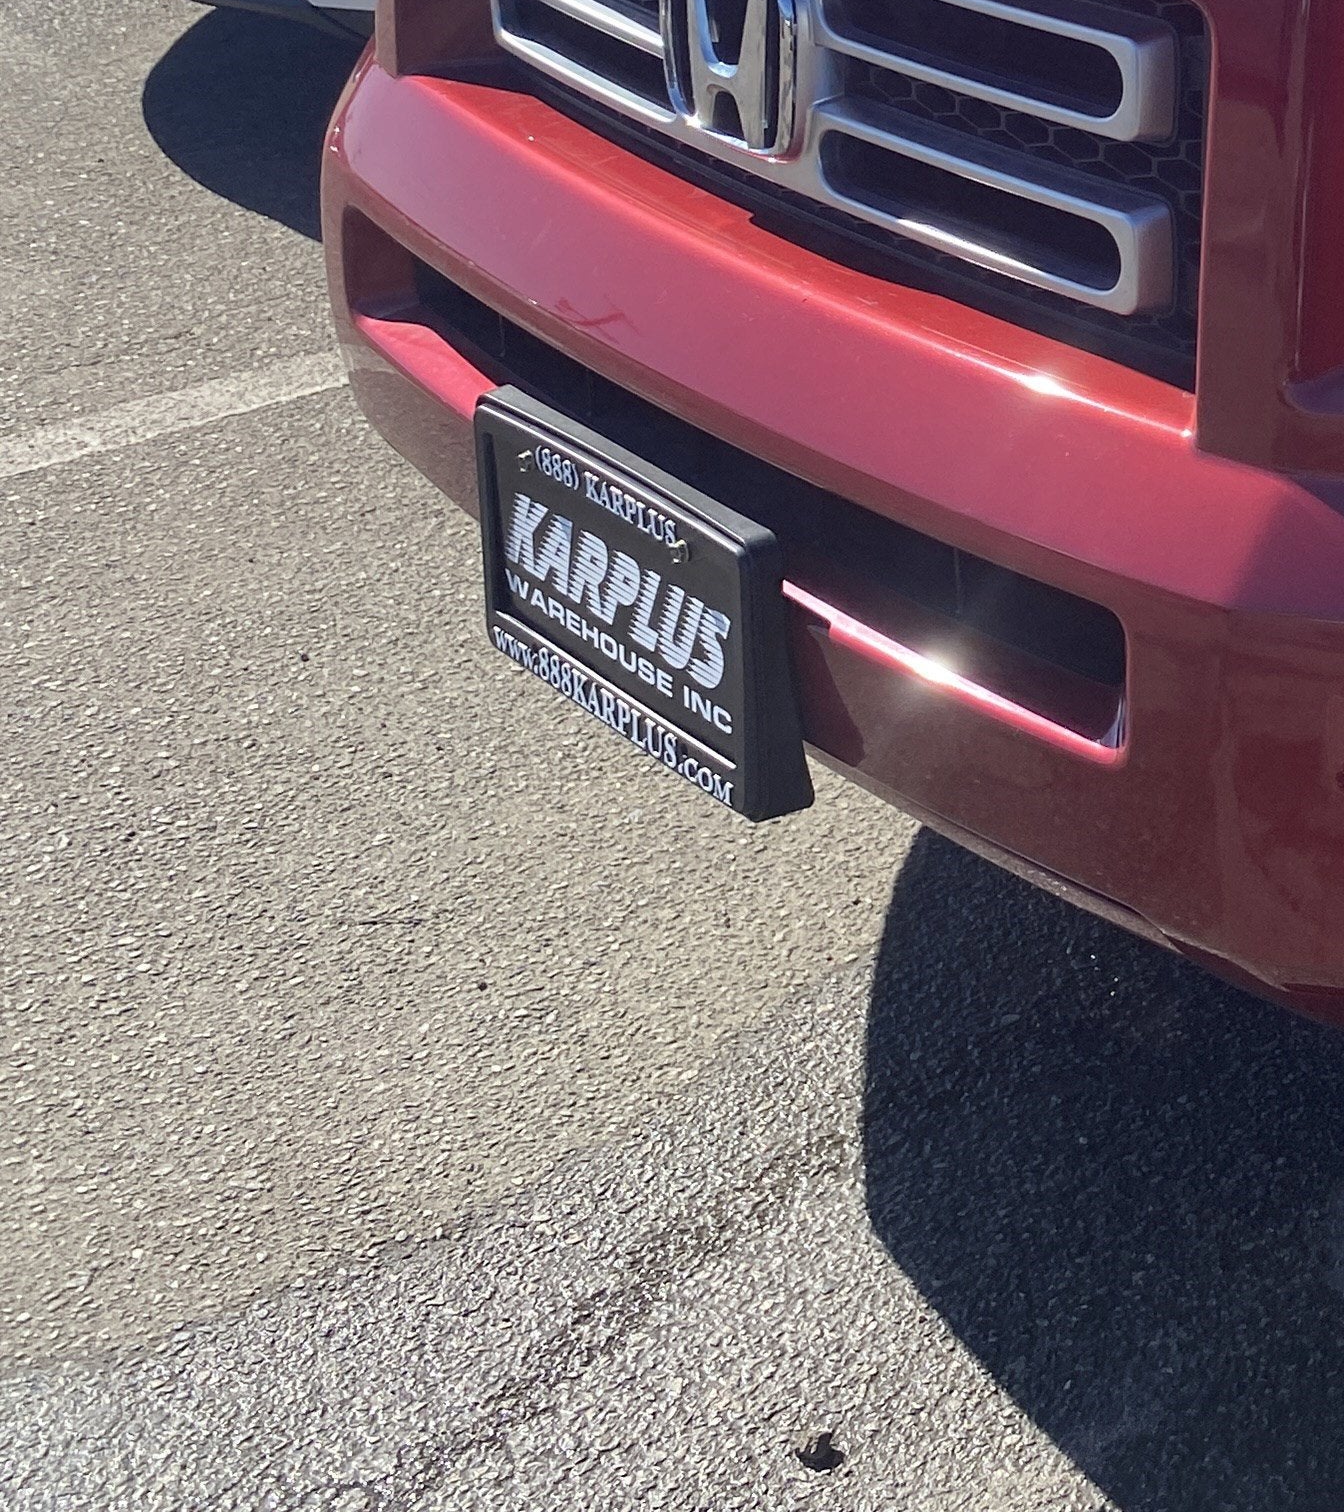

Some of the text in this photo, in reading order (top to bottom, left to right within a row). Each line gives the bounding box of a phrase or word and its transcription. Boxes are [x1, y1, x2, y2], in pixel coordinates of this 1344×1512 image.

[535, 445, 677, 548] (888) KARPLUS
[503, 569, 733, 735] WAREHOUSE INC
[505, 492, 731, 689] KARPLUS
